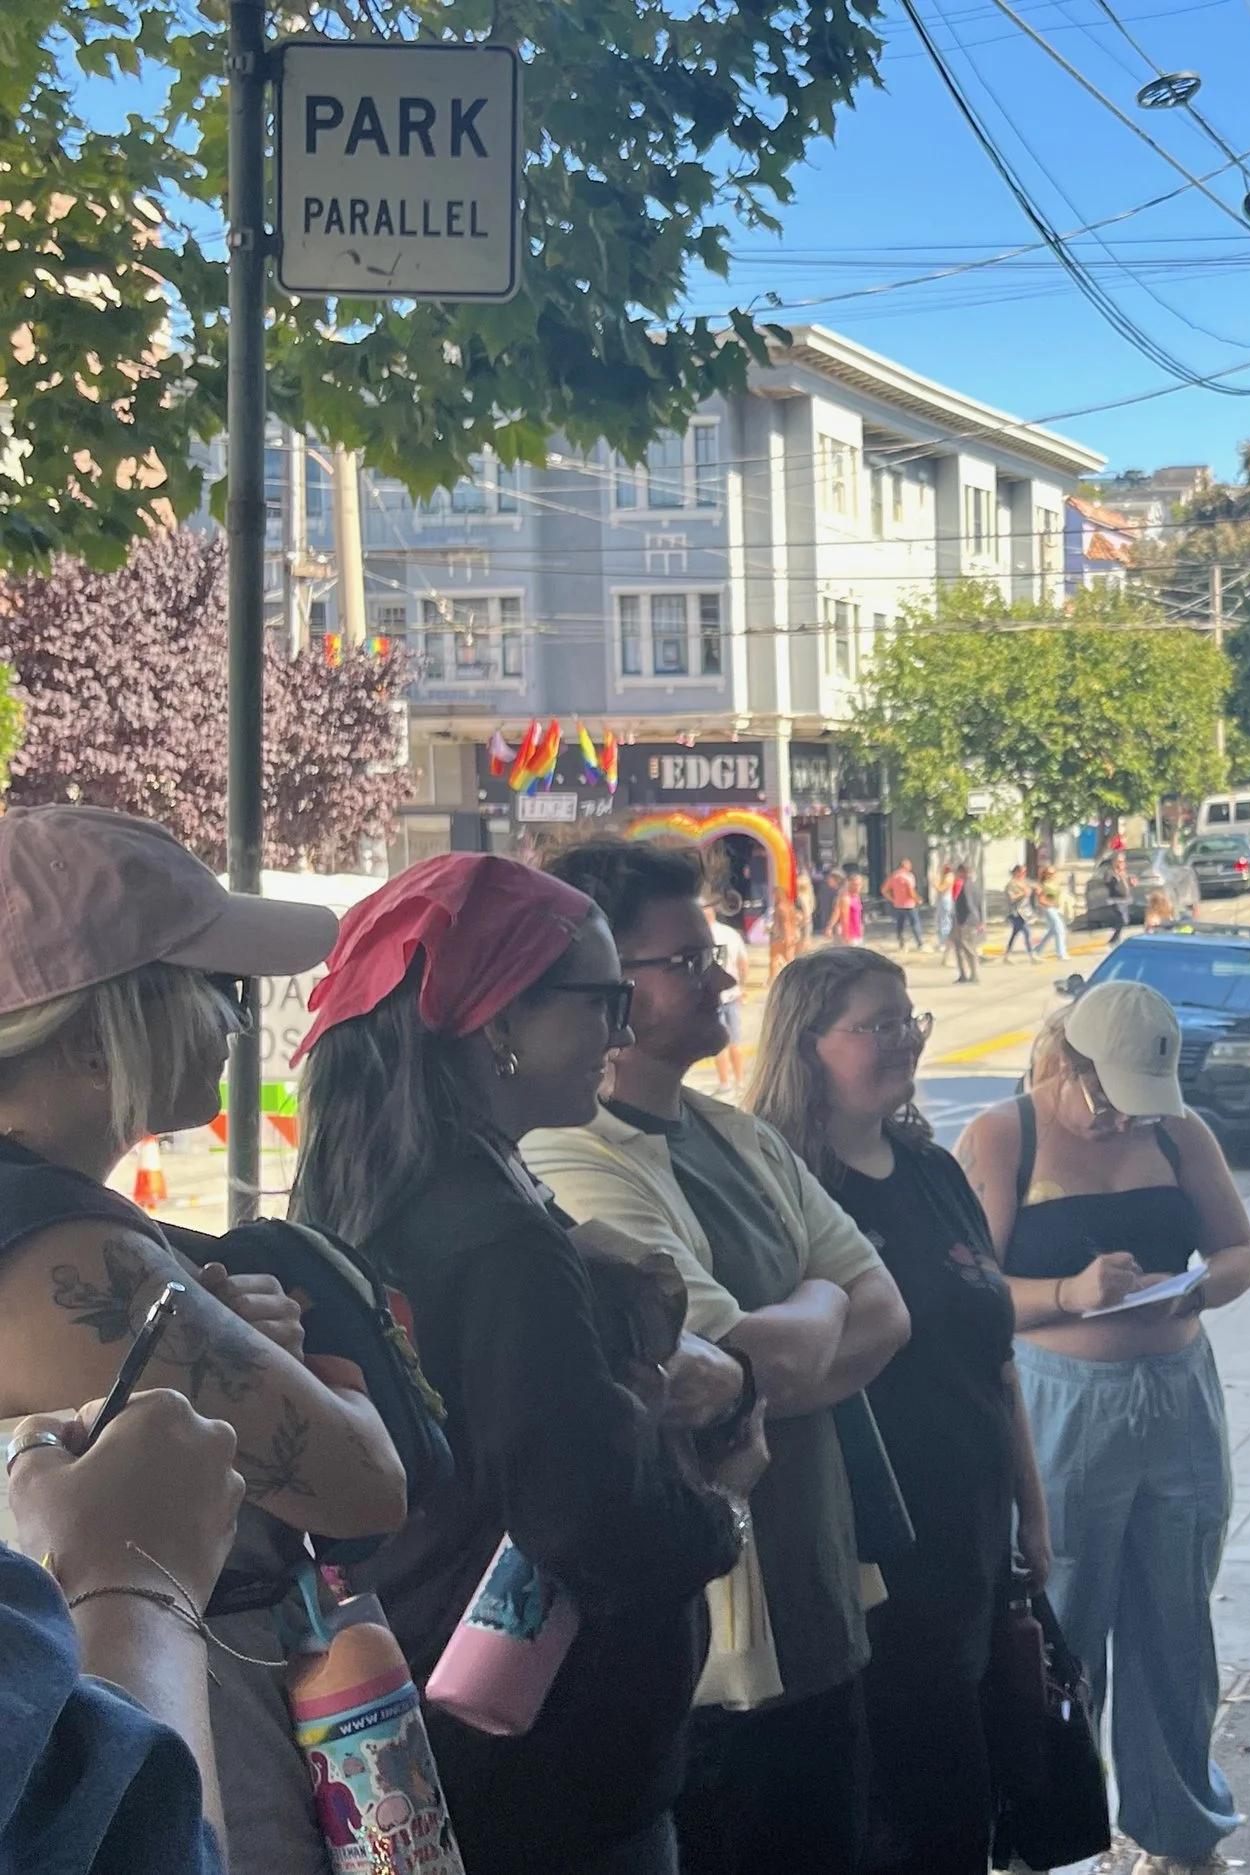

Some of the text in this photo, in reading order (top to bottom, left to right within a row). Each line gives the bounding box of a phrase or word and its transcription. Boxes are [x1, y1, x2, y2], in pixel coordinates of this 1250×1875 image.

[305, 95, 489, 158] PARK
[303, 196, 489, 239] PARALLEL
[661, 755, 760, 789] EDGE
